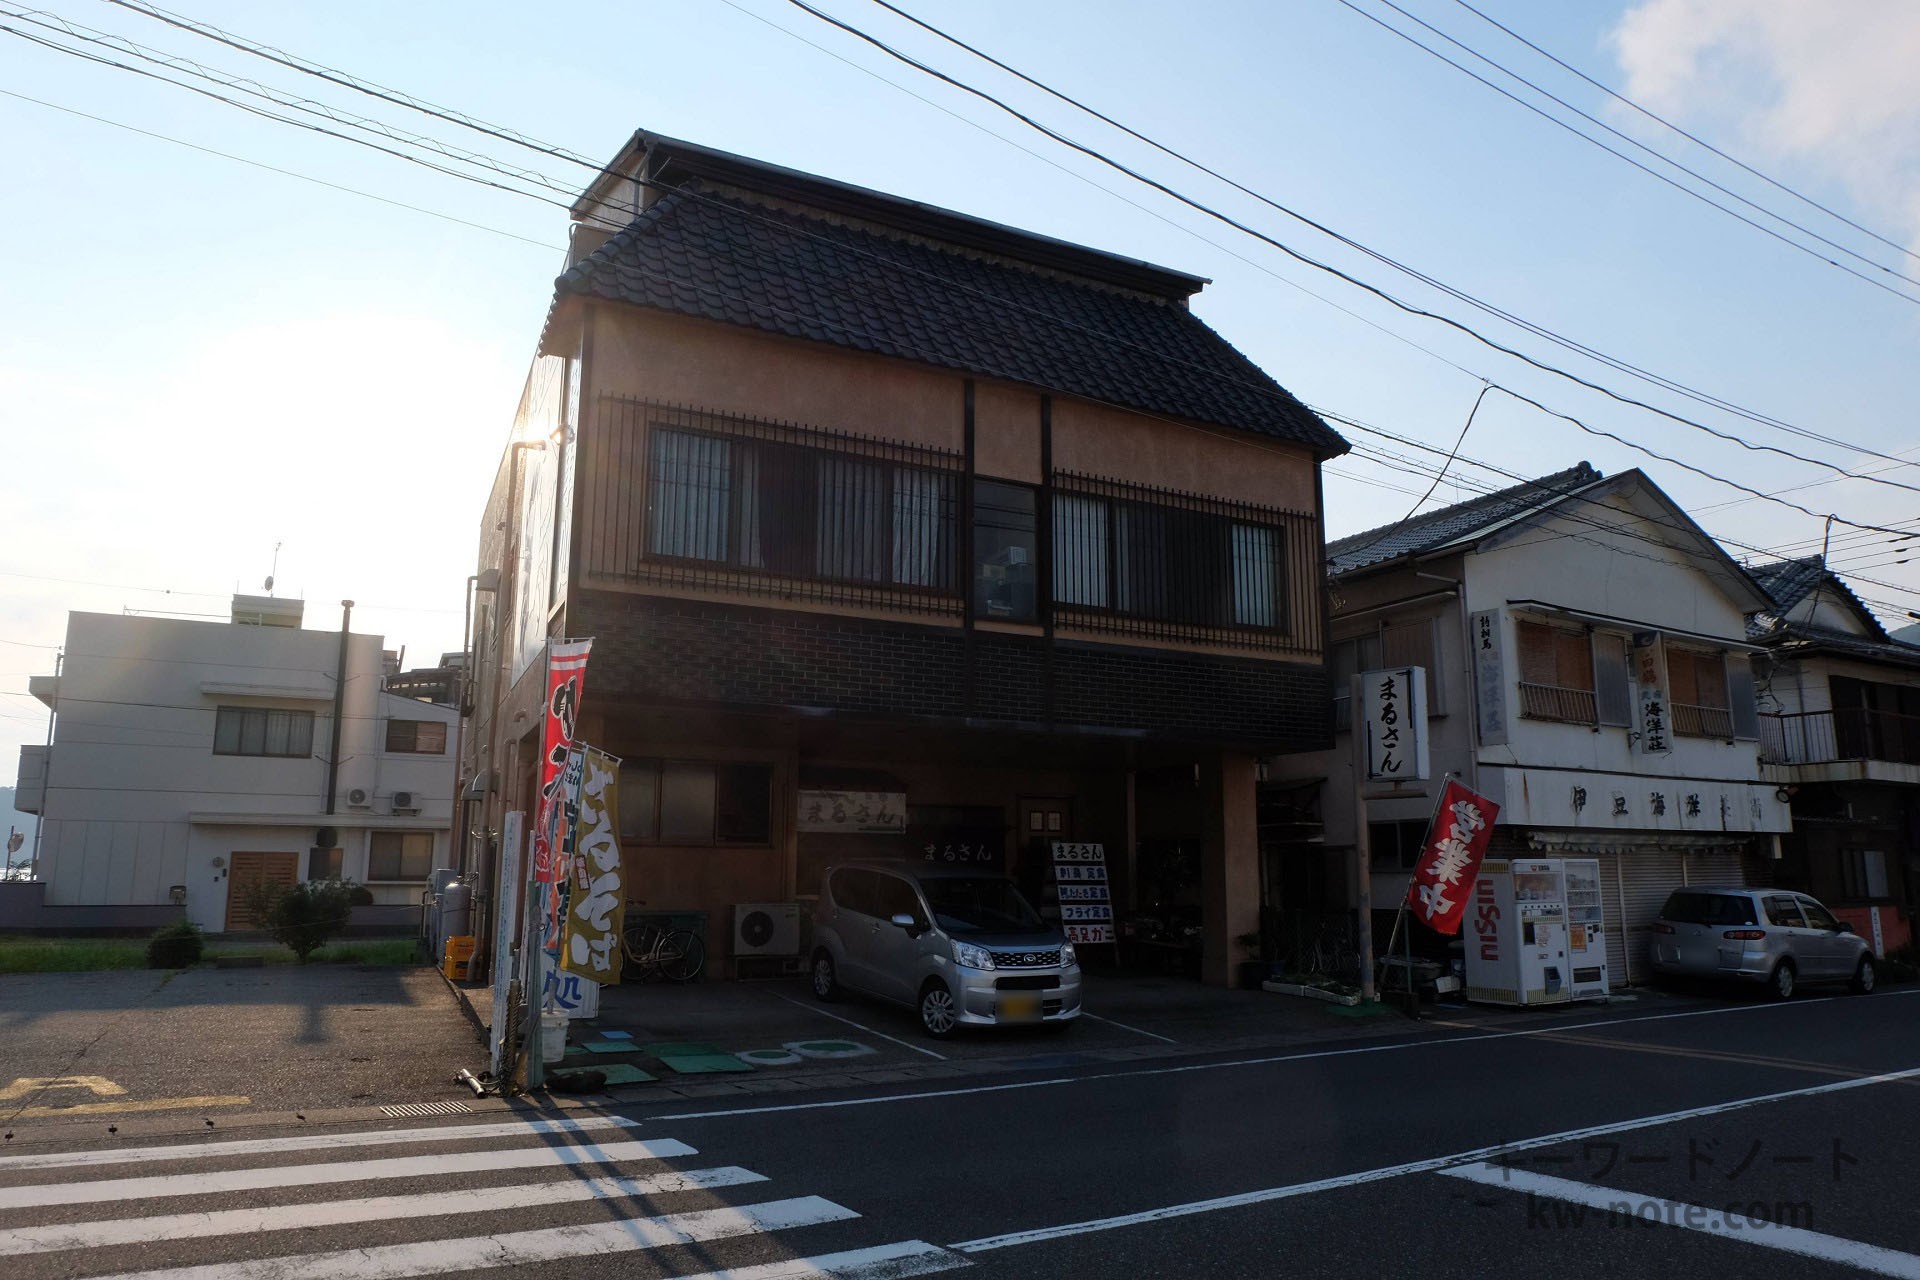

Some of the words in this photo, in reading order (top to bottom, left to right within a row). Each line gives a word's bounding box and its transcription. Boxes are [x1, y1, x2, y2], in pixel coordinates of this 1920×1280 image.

[1380, 676, 1402, 773] まるさん
[1645, 702, 1667, 752] 海洋荘
[808, 801, 896, 824] まるさん
[923, 842, 992, 862] まるさん
[1057, 844, 1102, 859] まるさん
[1418, 800, 1485, 920] 営業中
[1066, 906, 1110, 918] フライ定食
